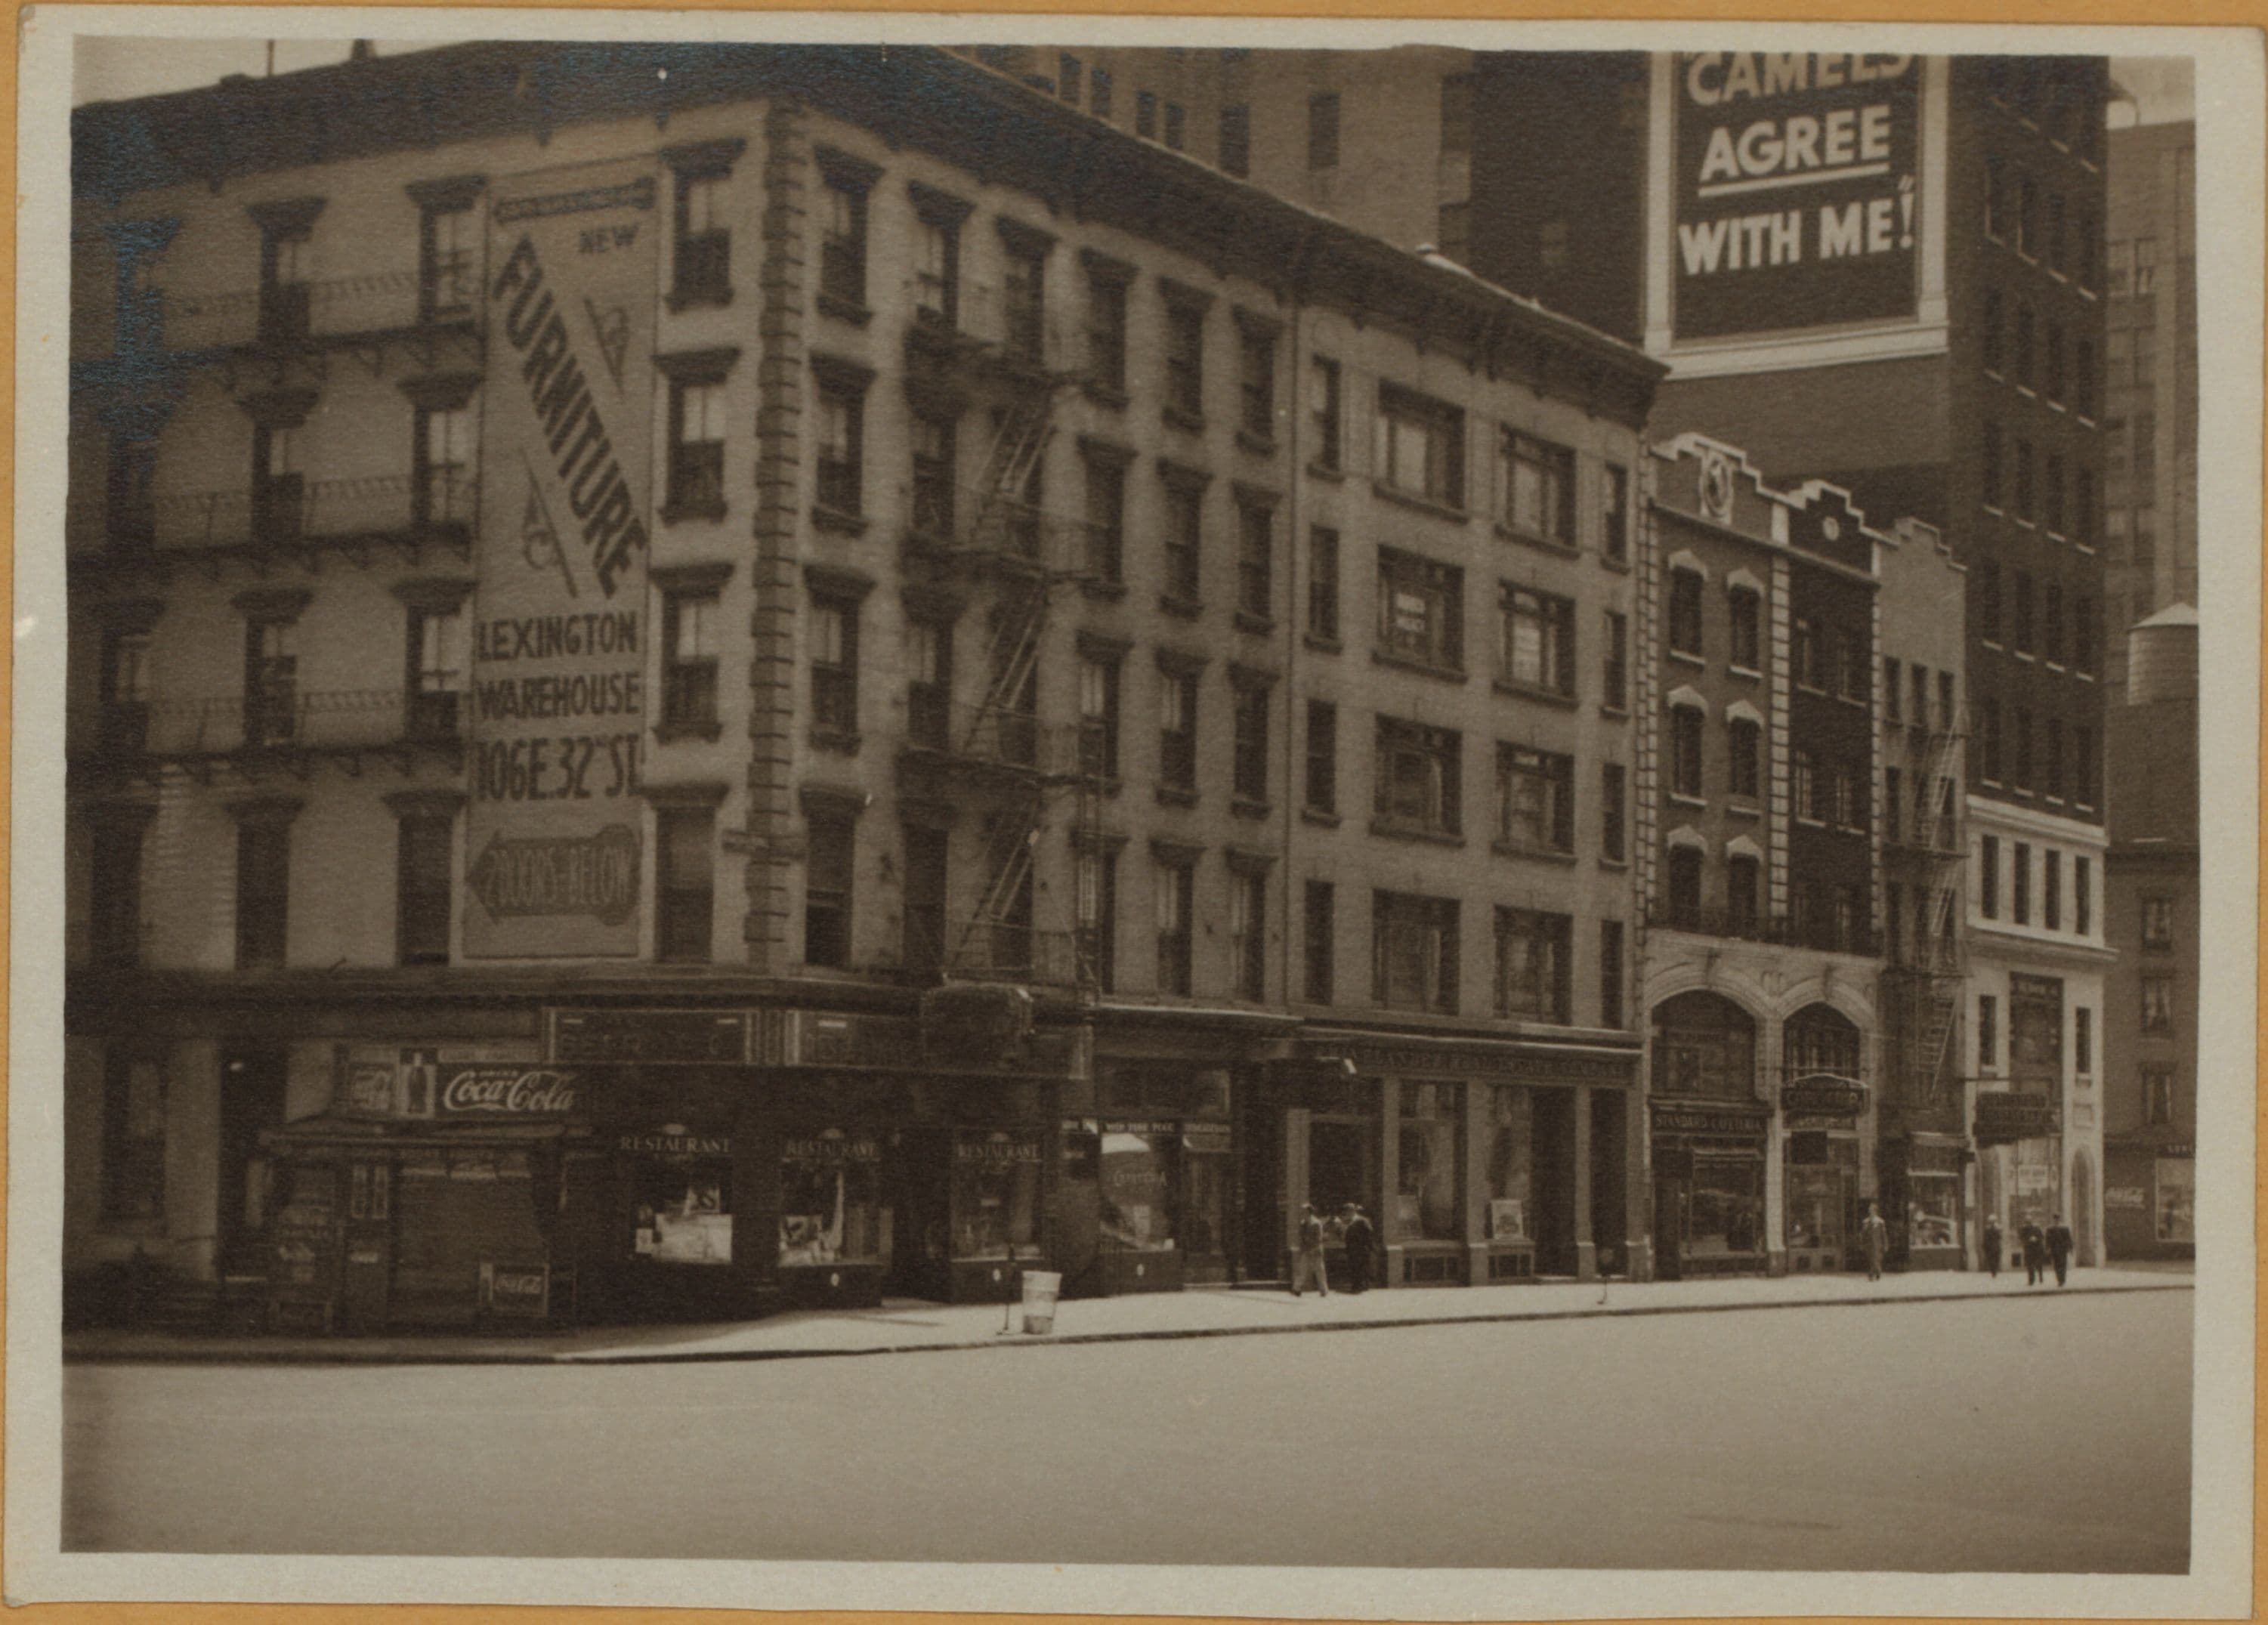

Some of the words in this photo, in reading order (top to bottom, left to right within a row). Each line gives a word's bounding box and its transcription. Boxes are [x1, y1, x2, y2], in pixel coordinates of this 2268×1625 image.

[1700, 104, 1890, 182] AGREE
[579, 223, 641, 255] NEW
[1677, 211, 1802, 276] WITH
[493, 233, 647, 599] FURNITURE
[477, 610, 637, 663] LEXINGTON
[476, 672, 641, 720] WAREHOUSE
[443, 1070, 577, 1112] Coca-Cola
[619, 1137, 731, 1155] RESTAURANT
[786, 1141, 877, 1157] RESTAURANT
[958, 1144, 1040, 1159] RESTAURANT
